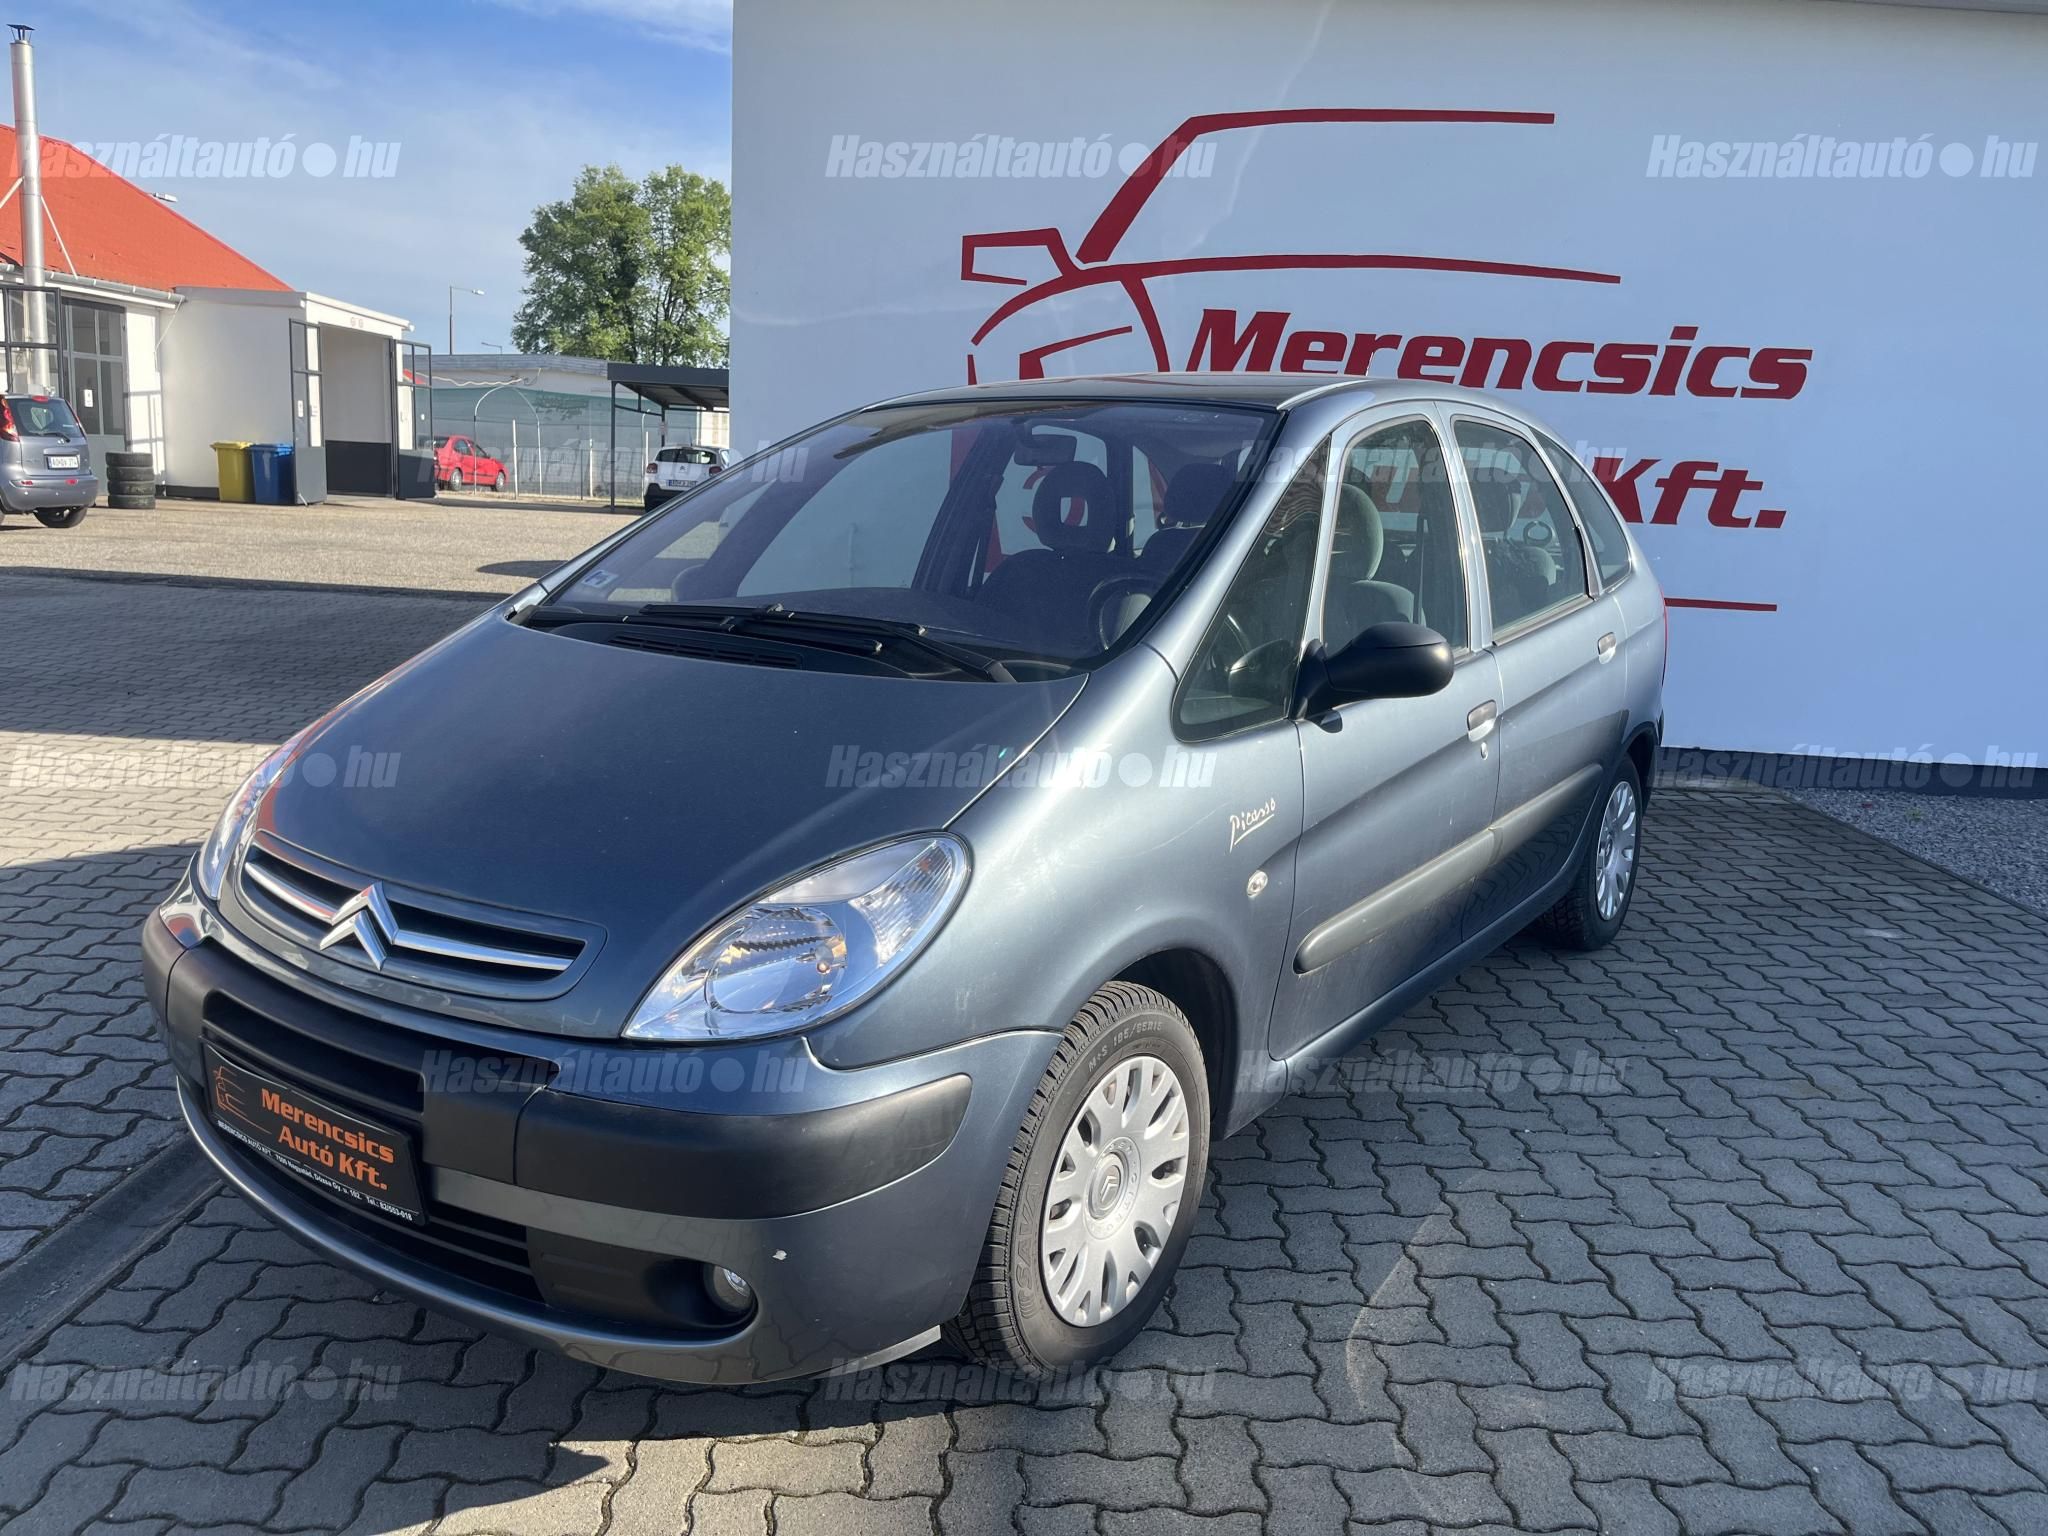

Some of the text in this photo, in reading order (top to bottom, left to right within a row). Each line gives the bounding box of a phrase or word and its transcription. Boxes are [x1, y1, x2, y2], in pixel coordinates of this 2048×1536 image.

[1186, 309, 1813, 400] Merencsics
[1594, 456, 1787, 529] Kft.
[1229, 797, 1277, 853] Picasso
[1088, 1044, 1109, 1072] M+S
[260, 1087, 394, 1165] Merencsics
[278, 1125, 388, 1191] Autó Kft.
